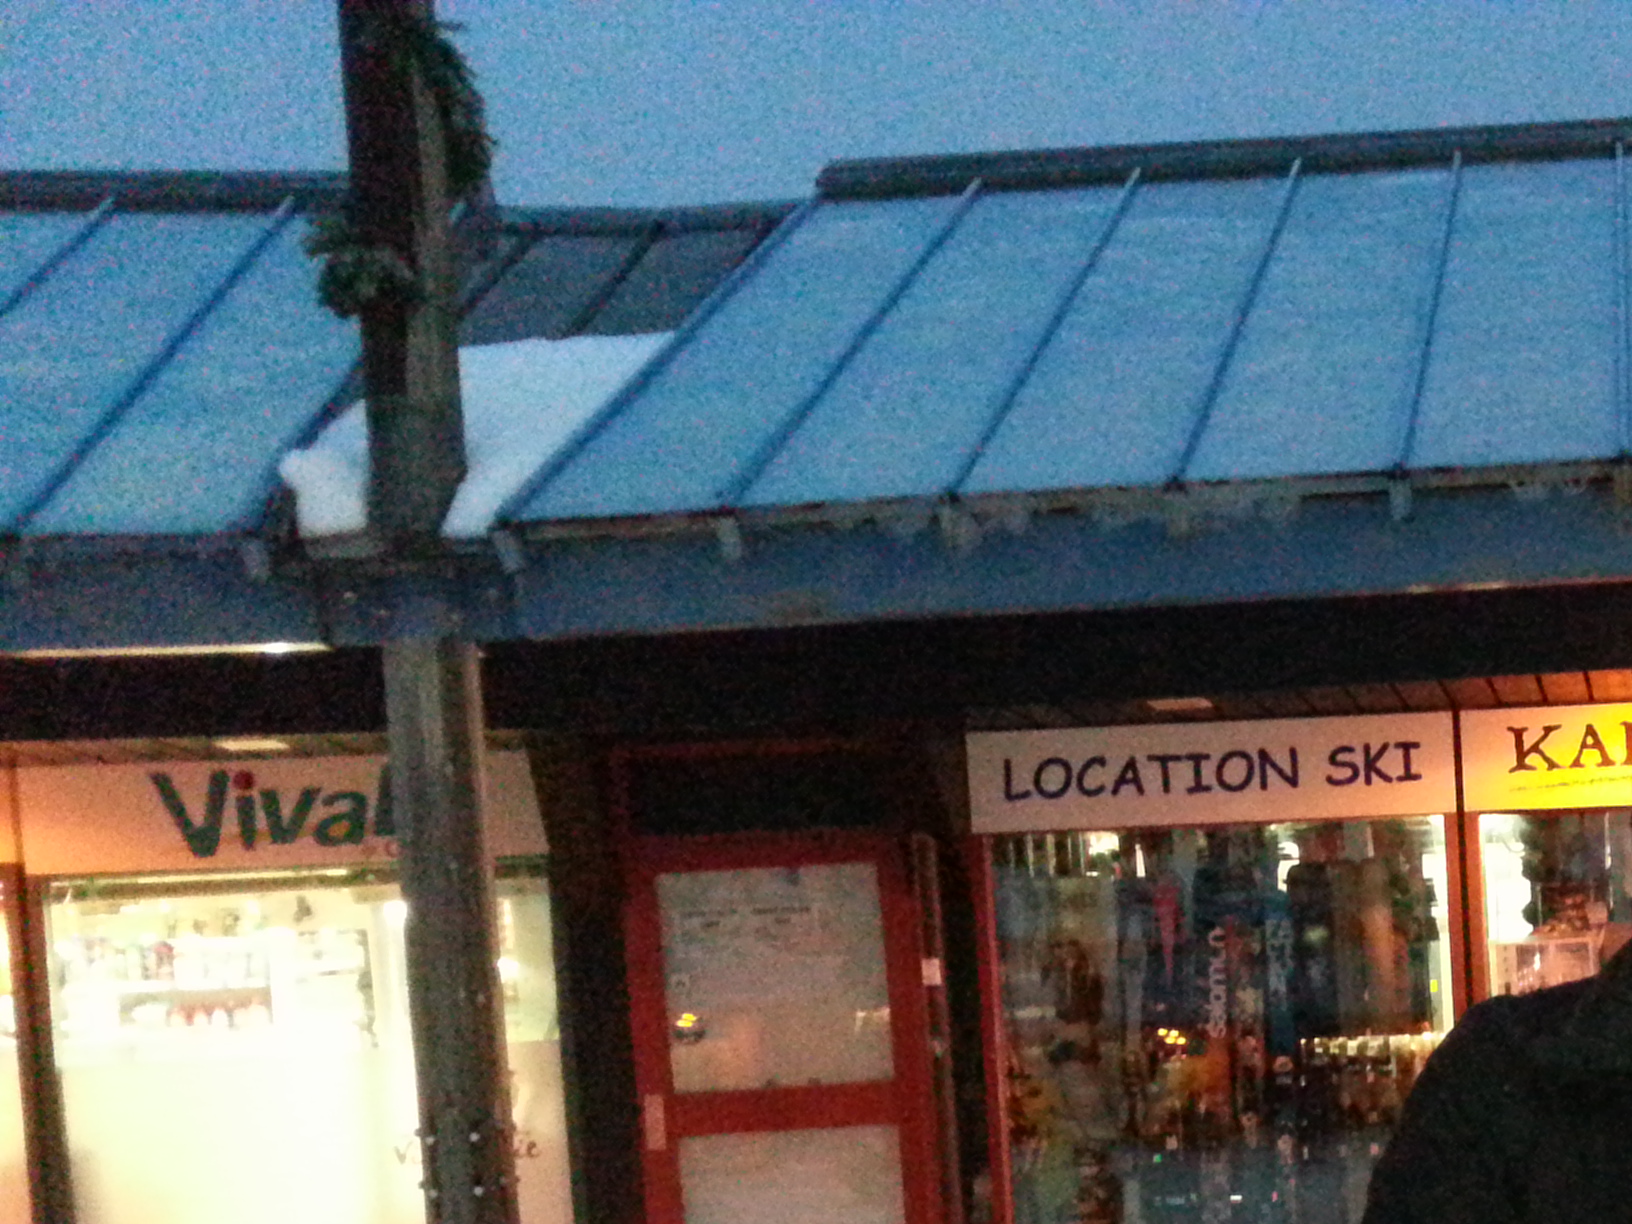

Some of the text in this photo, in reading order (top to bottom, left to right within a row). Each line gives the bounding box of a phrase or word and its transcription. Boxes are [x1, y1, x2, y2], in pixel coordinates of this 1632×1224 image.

[1003, 741, 1423, 801] LOCATION SKI
[151, 763, 396, 858] Vival
